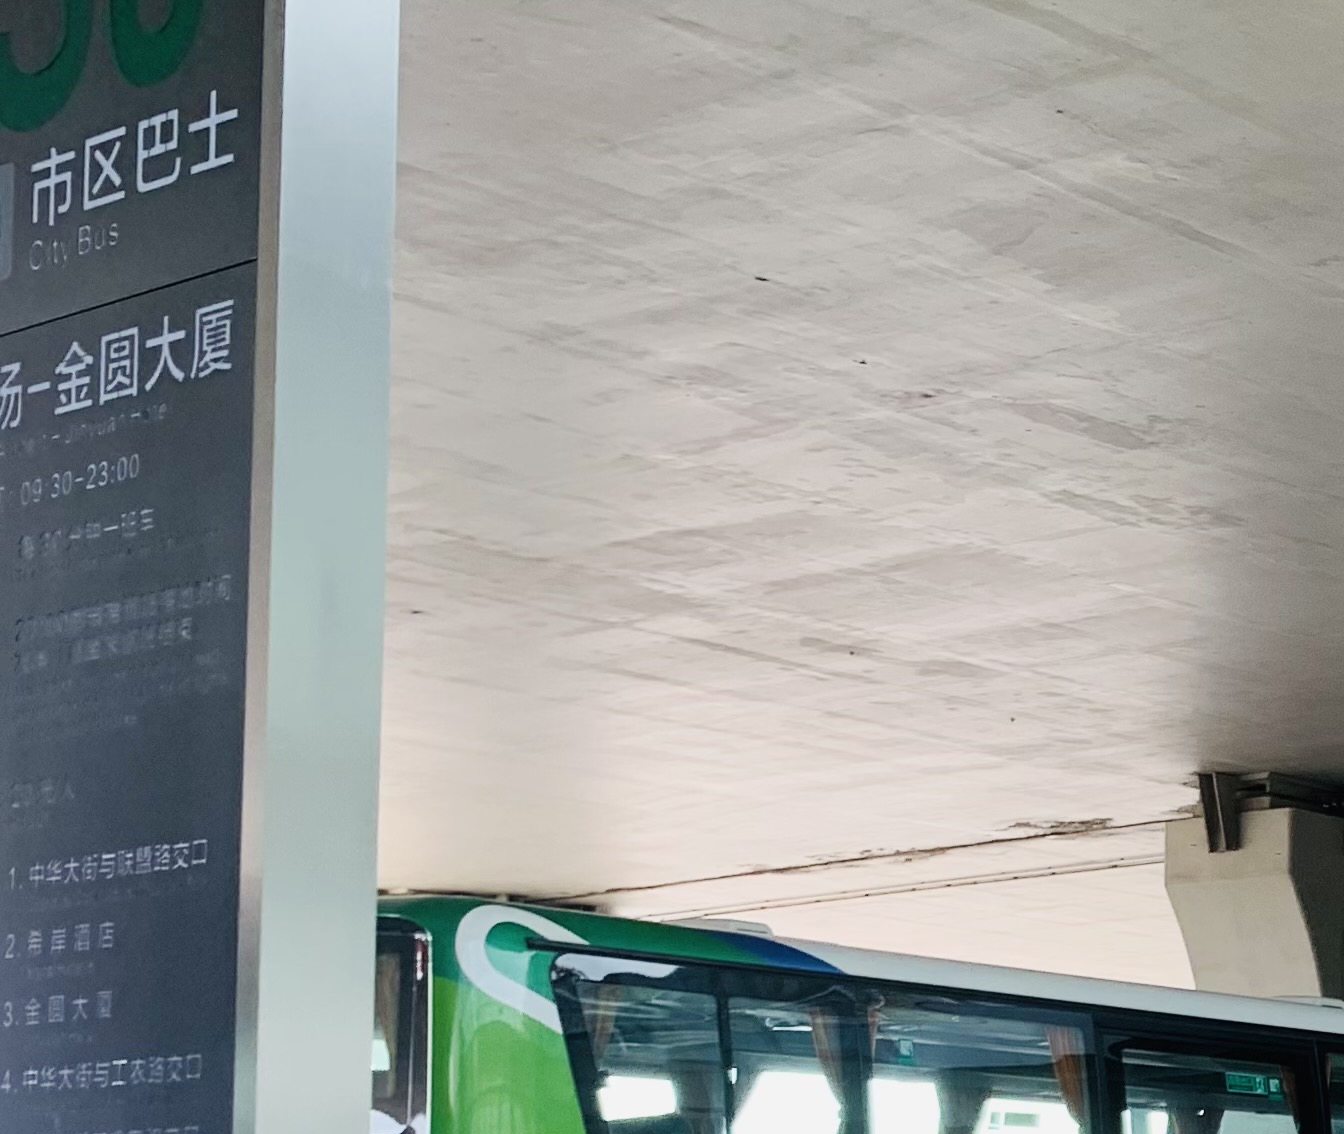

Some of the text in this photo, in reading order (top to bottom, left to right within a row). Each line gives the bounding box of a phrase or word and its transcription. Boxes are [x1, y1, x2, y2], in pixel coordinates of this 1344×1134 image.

[30, 90, 238, 226] 市区巴士
[78, 220, 119, 256] Bus
[20, 453, 140, 506] 09:30-23:00
